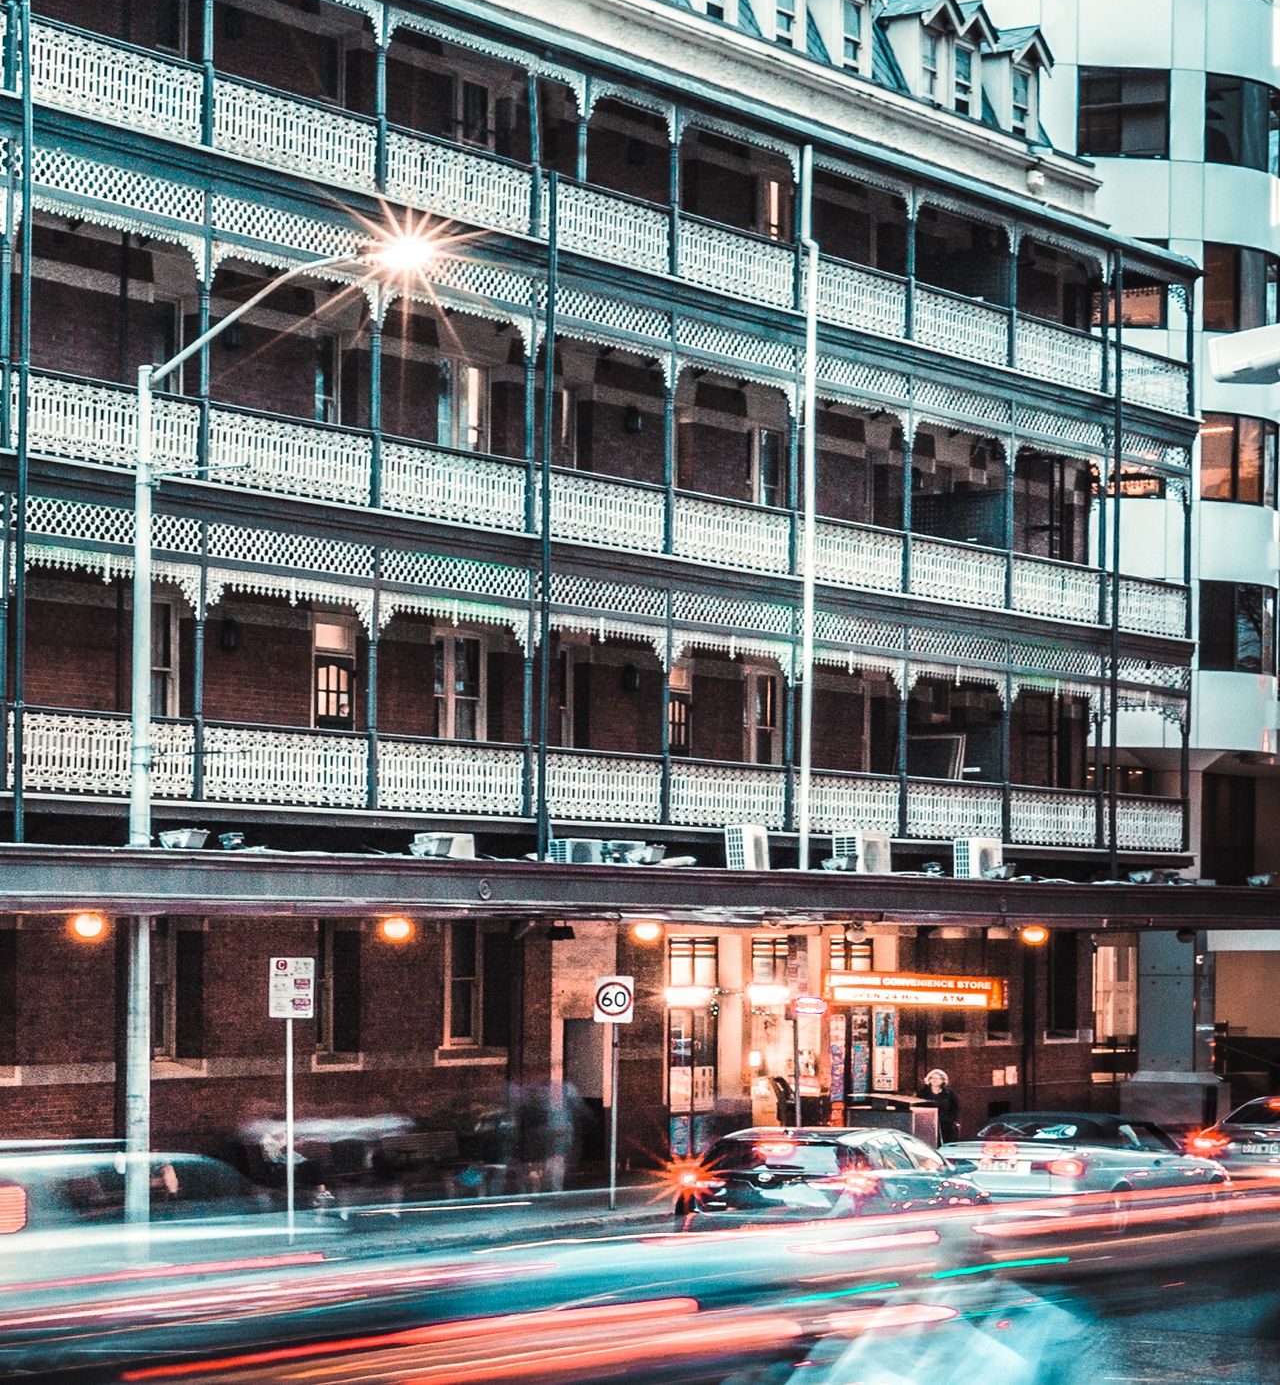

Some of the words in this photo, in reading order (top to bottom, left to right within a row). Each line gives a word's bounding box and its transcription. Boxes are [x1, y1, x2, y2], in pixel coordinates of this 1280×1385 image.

[882, 977, 955, 989] CONVENIENCE
[956, 980, 992, 990] STORE
[601, 991, 626, 1007] 60
[942, 995, 965, 1003] ATM
